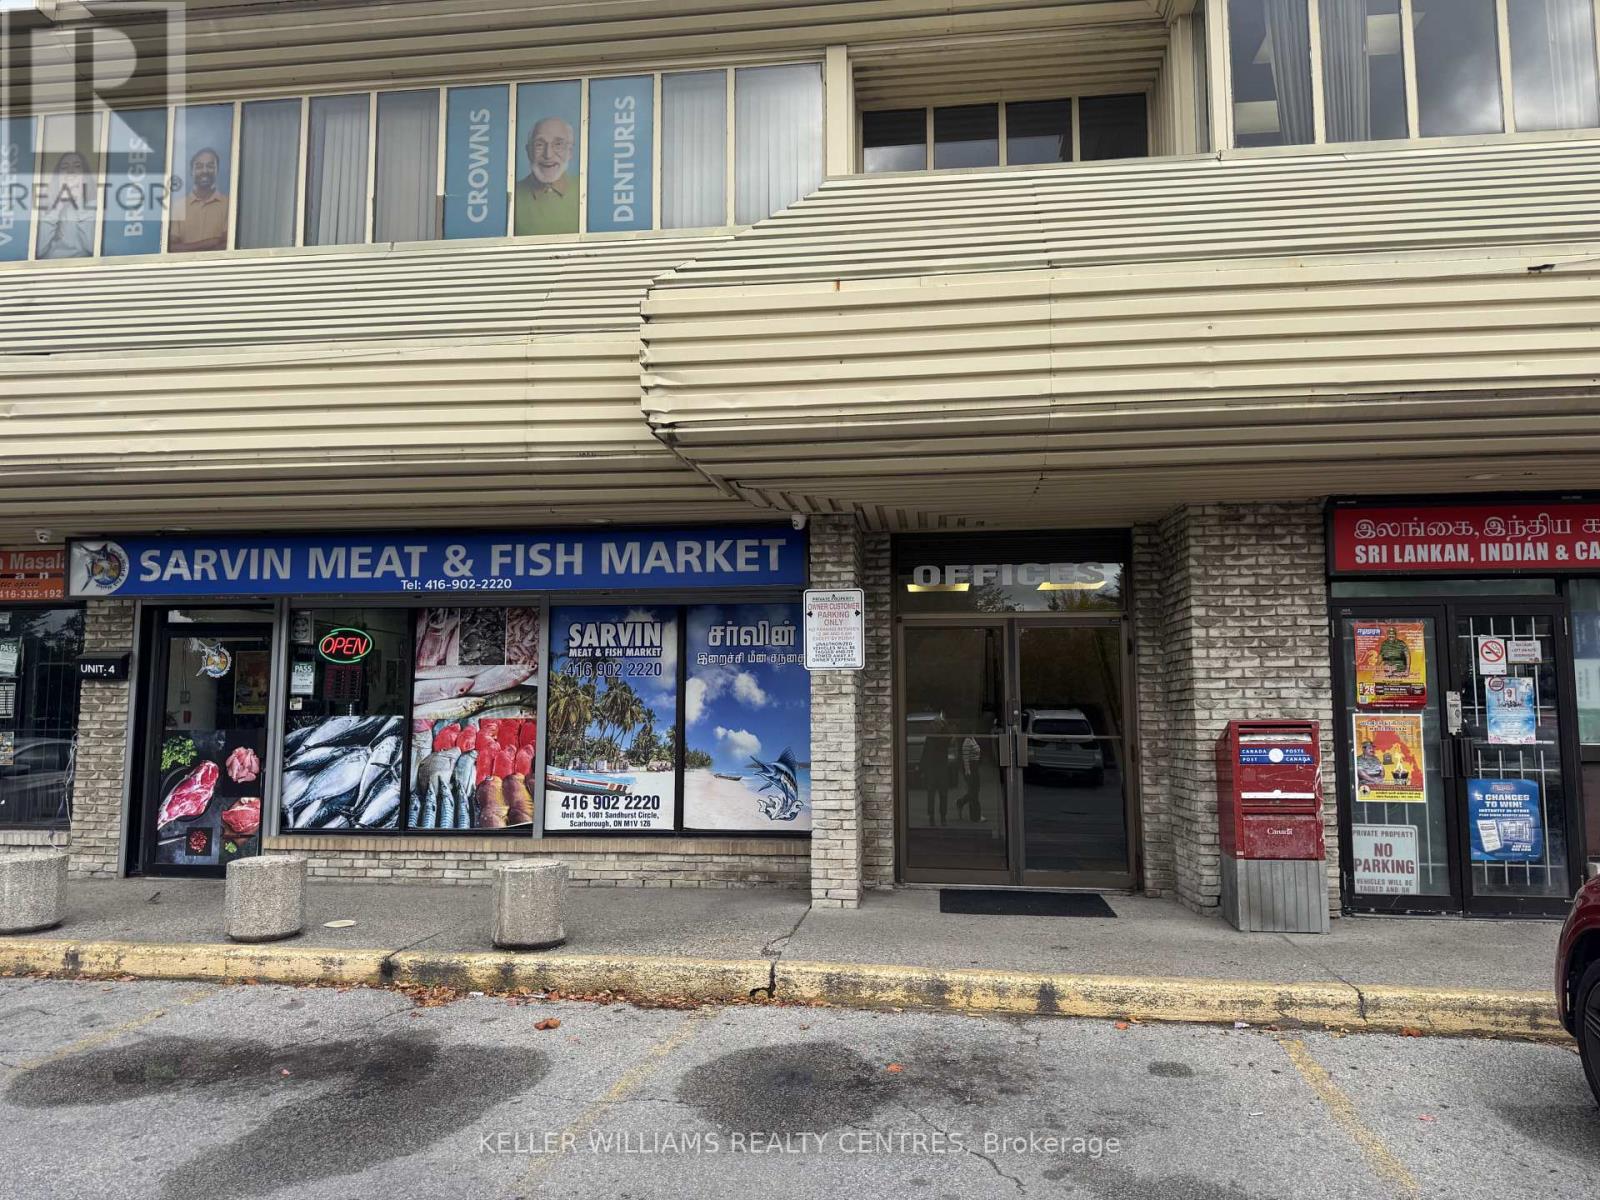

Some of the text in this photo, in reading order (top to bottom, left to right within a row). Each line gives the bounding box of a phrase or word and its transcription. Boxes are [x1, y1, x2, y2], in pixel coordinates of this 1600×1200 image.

[467, 108, 490, 223] CROWNS
[613, 95, 636, 222] DENTURES
[124, 137, 148, 237] BRIDGES
[1483, 512, 1572, 541] இந்திய
[139, 547, 291, 582] SARVIN
[308, 545, 428, 580] MEAT
[443, 544, 474, 578] &
[491, 542, 583, 577] FISH
[602, 538, 787, 575] MARKET
[1355, 544, 1388, 564] SRI
[1393, 543, 1475, 564] LANKAN,
[1480, 541, 1549, 562] INDIAN
[1555, 544, 1569, 561] &
[10, 552, 65, 570] Masal
[913, 561, 1105, 586] OFFICES
[400, 578, 512, 591] Tel: 416-902-2220
[817, 610, 850, 619] PARKING
[823, 618, 843, 626] ONLY
[568, 622, 662, 648] SARVIN
[0, 643, 17, 653] PASS
[321, 637, 368, 655] OPEN
[568, 647, 662, 658] MEAT & FISH MARKET
[294, 665, 313, 673] PASS
[565, 662, 662, 677] 416 902 2220
[561, 795, 661, 810] 416 902 2220
[1484, 793, 1530, 801] CHANCES
[561, 811, 660, 820] Unit 04, 1001 Sandhurst Circle,
[569, 819, 612, 829] Scarborough,
[613, 819, 622, 828] ON
[623, 819, 638, 828] M1V
[1353, 829, 1414, 839] PRIVATE PROPERTY
[1373, 842, 1393, 858] NO
[1354, 858, 1415, 875] PARKING
[1387, 879, 1402, 887] WILL
